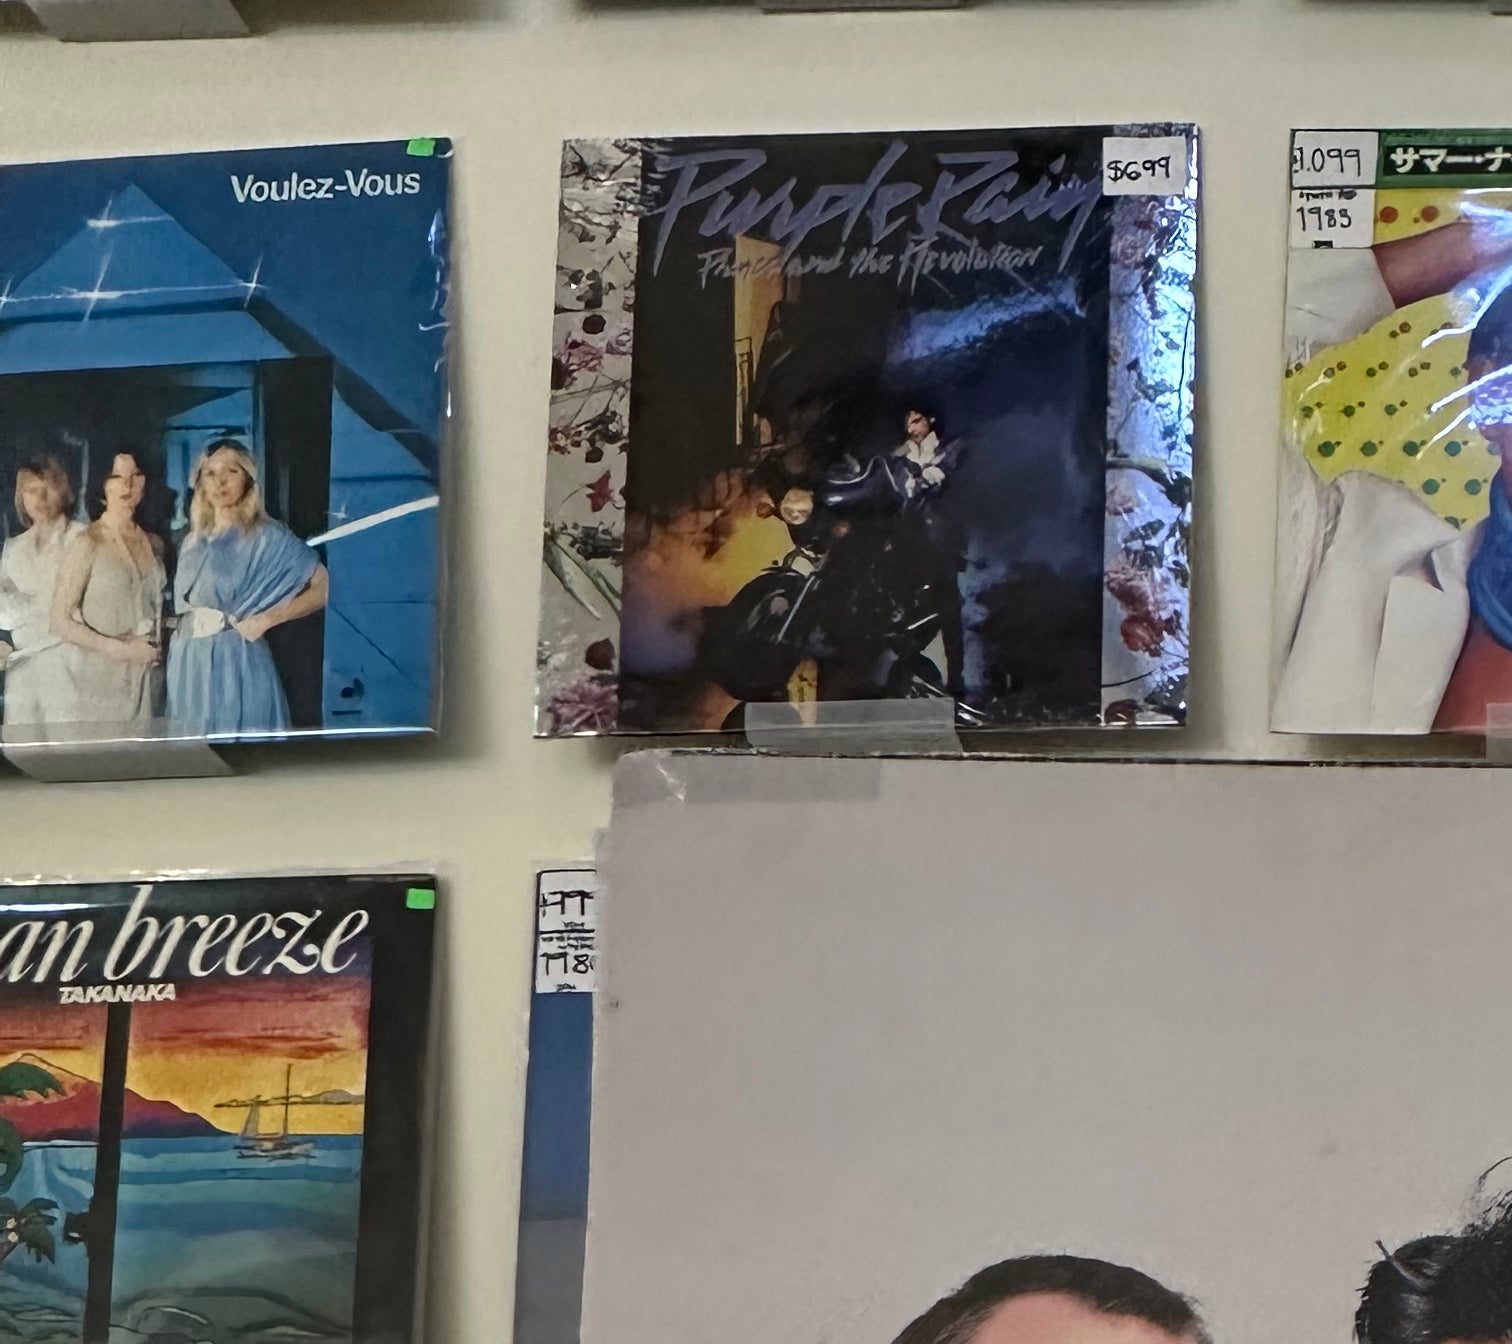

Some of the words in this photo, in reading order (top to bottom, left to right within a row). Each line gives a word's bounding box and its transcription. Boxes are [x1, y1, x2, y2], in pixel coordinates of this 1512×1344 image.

[230, 168, 421, 204] Voulez-Vous
[1106, 156, 1173, 183] $699
[651, 139, 923, 278] Purple
[102, 884, 371, 982] breeze
[59, 983, 177, 1004] TAKANAKA
